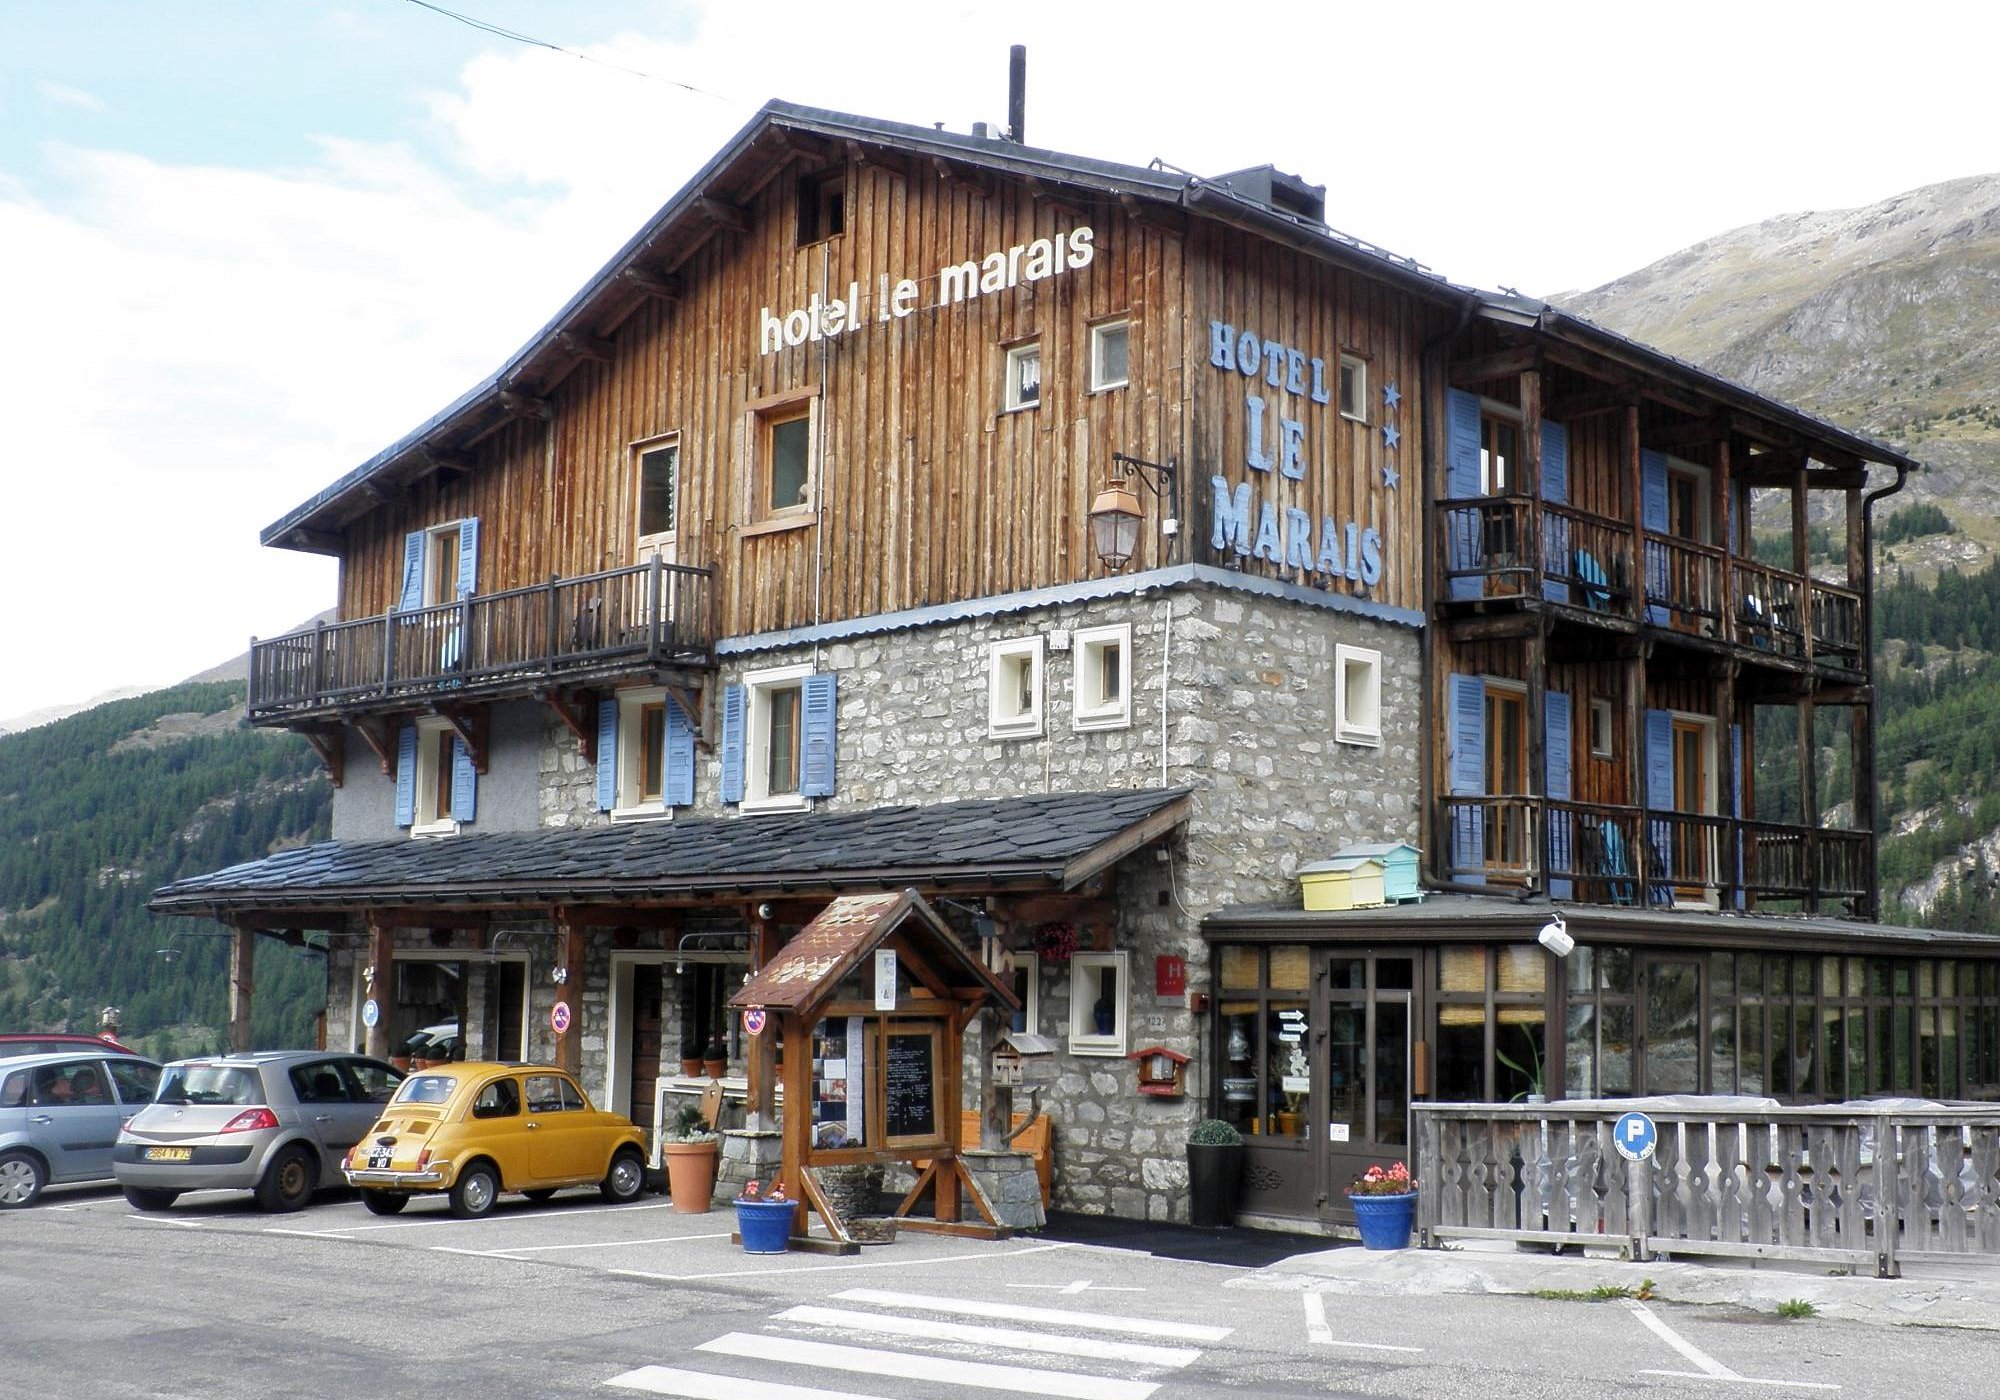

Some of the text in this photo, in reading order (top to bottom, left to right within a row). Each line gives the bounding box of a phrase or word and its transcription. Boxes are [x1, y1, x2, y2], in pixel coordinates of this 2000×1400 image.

[761, 226, 1094, 355] hotel le marais
[1209, 320, 1330, 405] HOTEL
[1246, 395, 1306, 481] LE
[1211, 475, 1382, 586] MARAIS
[1627, 1119, 1644, 1142] P
